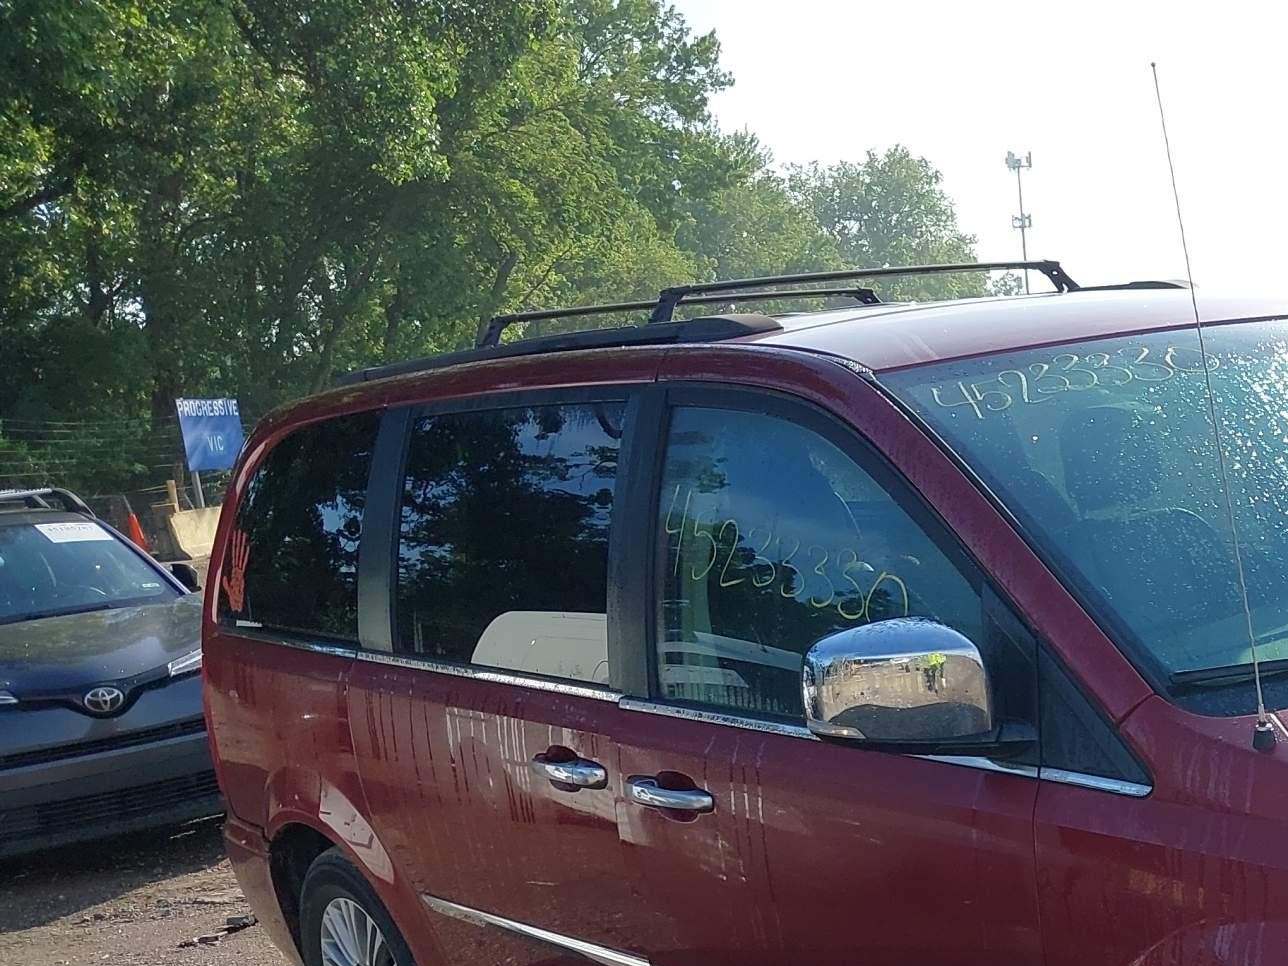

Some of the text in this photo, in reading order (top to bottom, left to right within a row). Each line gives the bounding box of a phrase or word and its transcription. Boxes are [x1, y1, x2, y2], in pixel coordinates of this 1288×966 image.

[930, 346, 1220, 420] 45233330
[176, 399, 239, 416] PROGRESSIVE
[207, 435, 224, 451] VIC
[665, 484, 909, 623] 45233330
